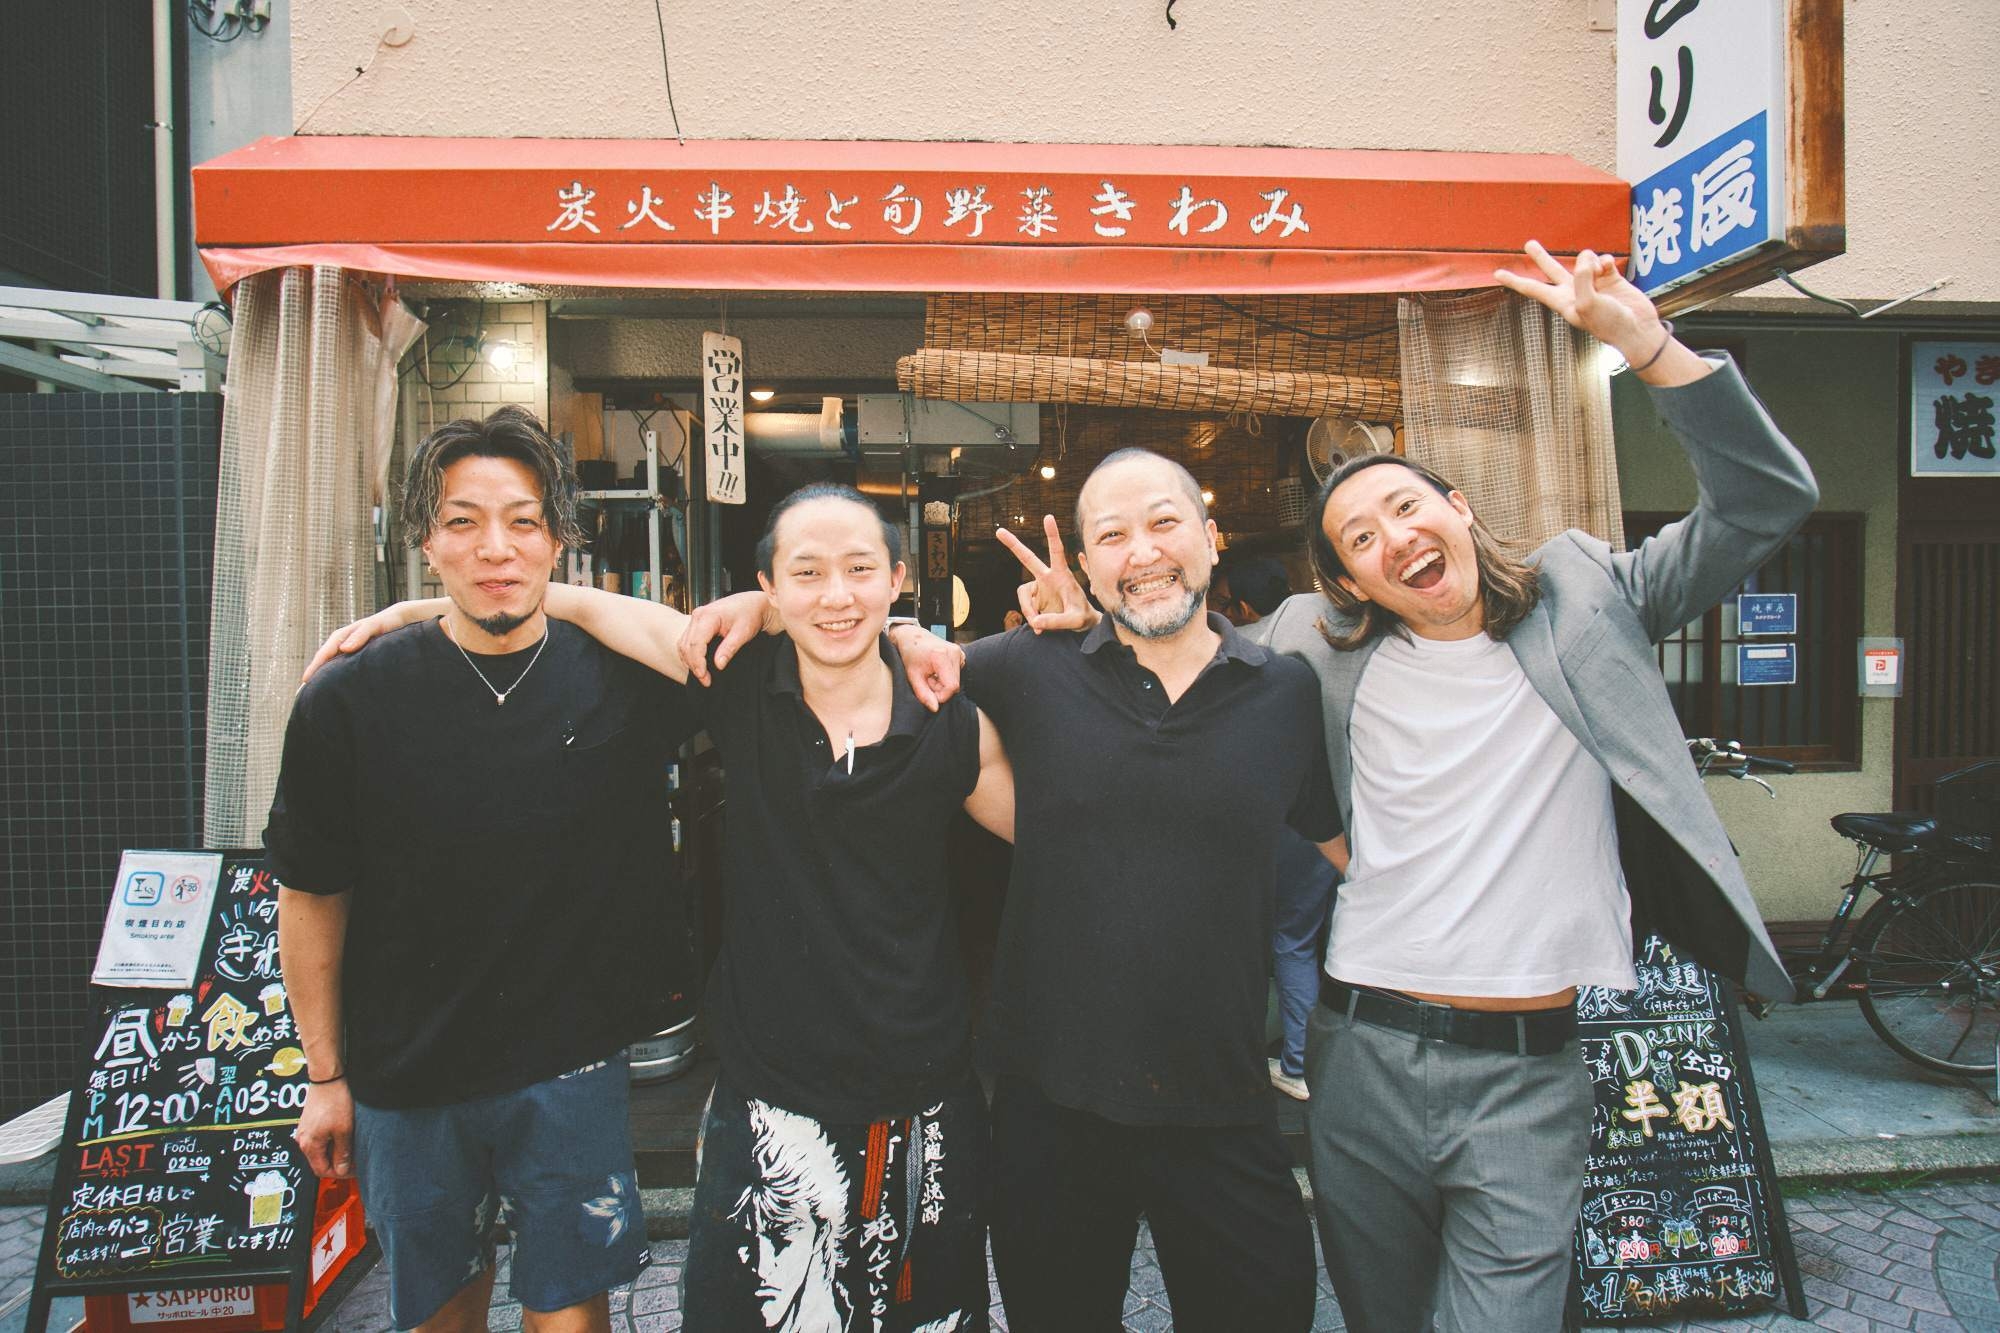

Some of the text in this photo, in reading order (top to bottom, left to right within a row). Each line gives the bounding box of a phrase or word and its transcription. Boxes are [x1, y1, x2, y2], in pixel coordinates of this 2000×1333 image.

[546, 181, 1311, 241] 炭火串焼と旬野菜きわみ
[1932, 392, 1997, 460] 焼
[231, 868, 281, 896] 炭火
[129, 932, 158, 941] Smoking
[93, 992, 303, 1068] 昼から飲めま
[1611, 1022, 1720, 1080] DRINK
[1680, 1048, 1732, 1081] 全品
[1621, 1079, 1736, 1138] 半額
[80, 1144, 155, 1171] LAST
[163, 1138, 196, 1156] Food
[233, 1138, 272, 1151] Drink
[155, 1284, 251, 1308] SAPPORO
